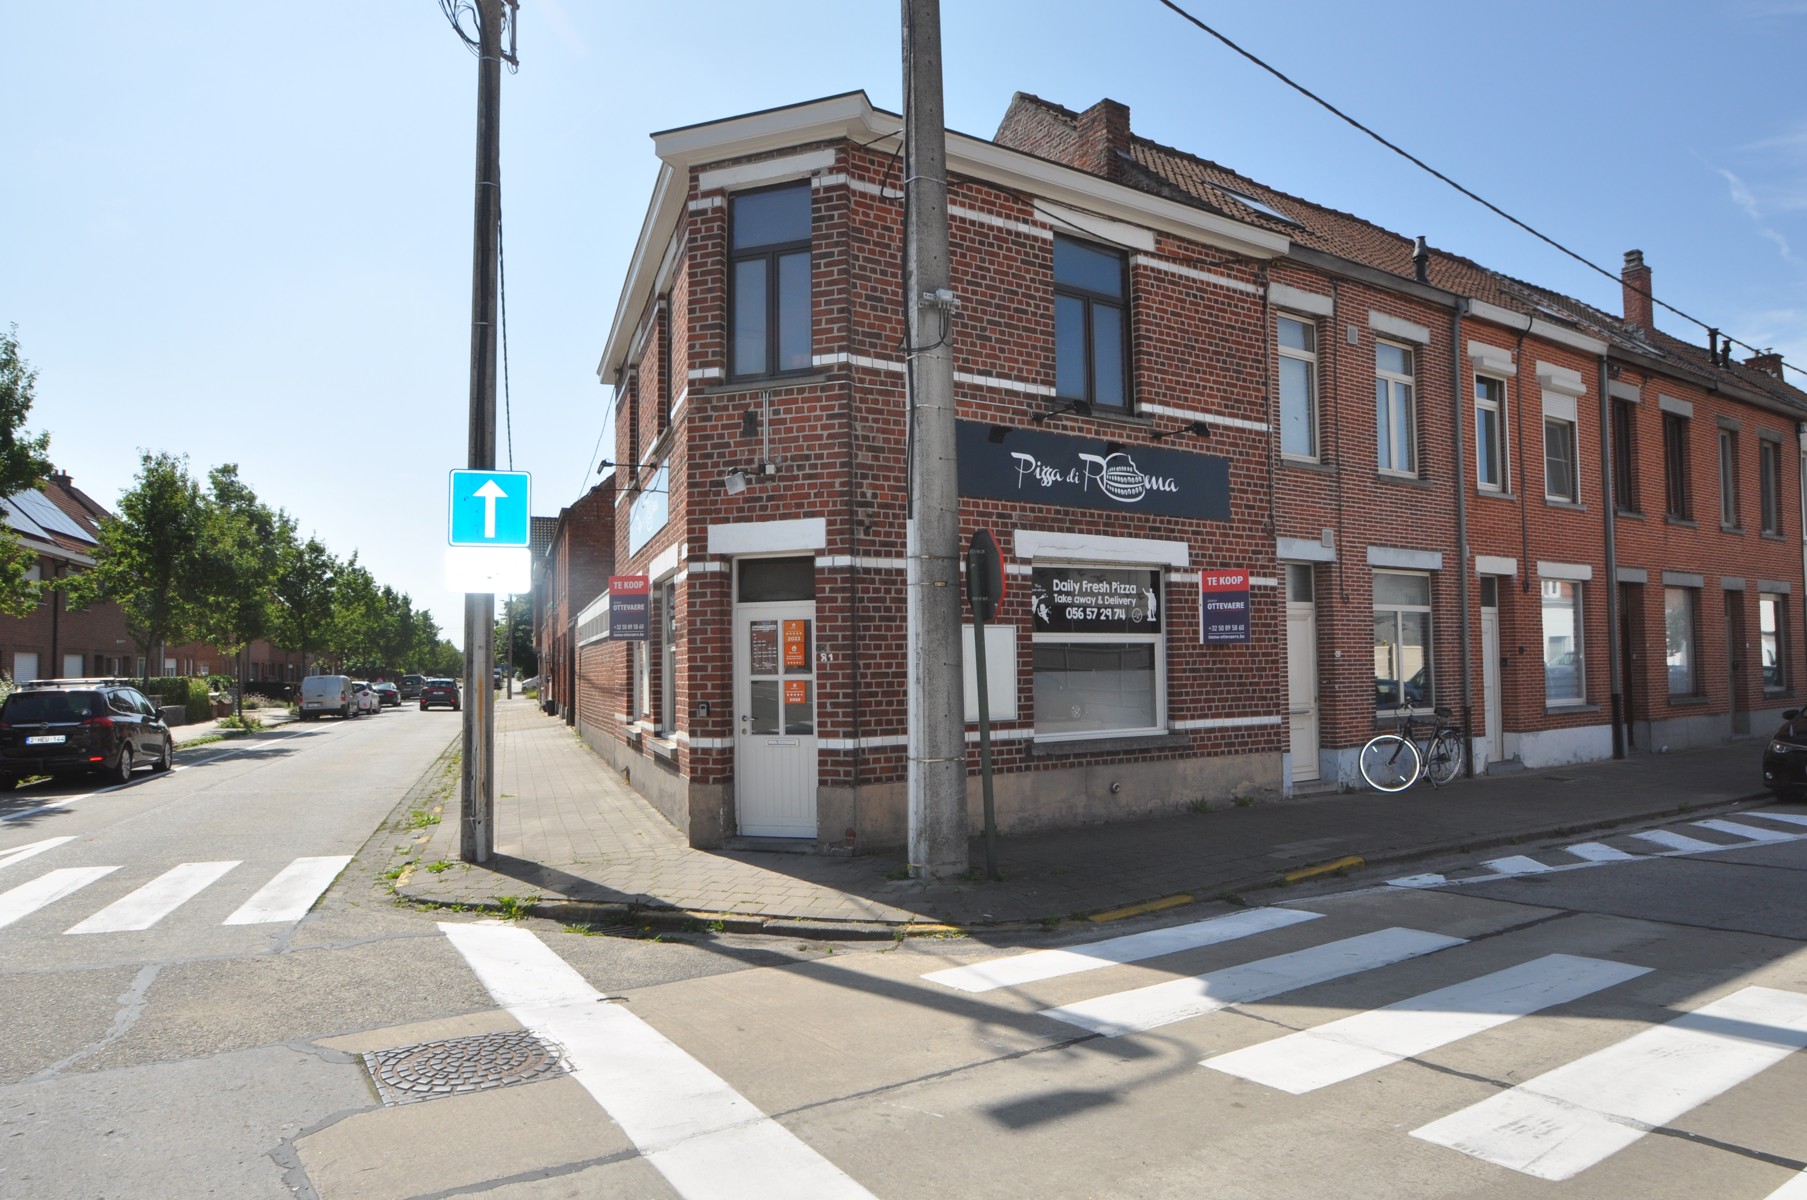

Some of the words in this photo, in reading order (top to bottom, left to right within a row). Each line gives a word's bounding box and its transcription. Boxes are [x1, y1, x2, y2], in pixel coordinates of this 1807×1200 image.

[1011, 452, 1064, 489] Pizza
[1066, 468, 1080, 484] di
[624, 581, 644, 589] KOOP
[1207, 577, 1217, 585] TE
[1220, 576, 1243, 585] KOOP
[1053, 579, 1080, 594] Daily
[1082, 581, 1110, 593] Fresh
[1112, 582, 1137, 594] Pizza
[1053, 594, 1072, 603] Take
[1074, 596, 1096, 606] away
[1098, 596, 1103, 604] &
[1104, 596, 1136, 607] Delivery
[1207, 602, 1245, 610] OTTEVAERE
[1066, 607, 1084, 620] 056
[1086, 608, 1098, 620] 57
[1100, 608, 1112, 620] 29
[1113, 608, 1126, 620] 74
[820, 652, 833, 662] 81
